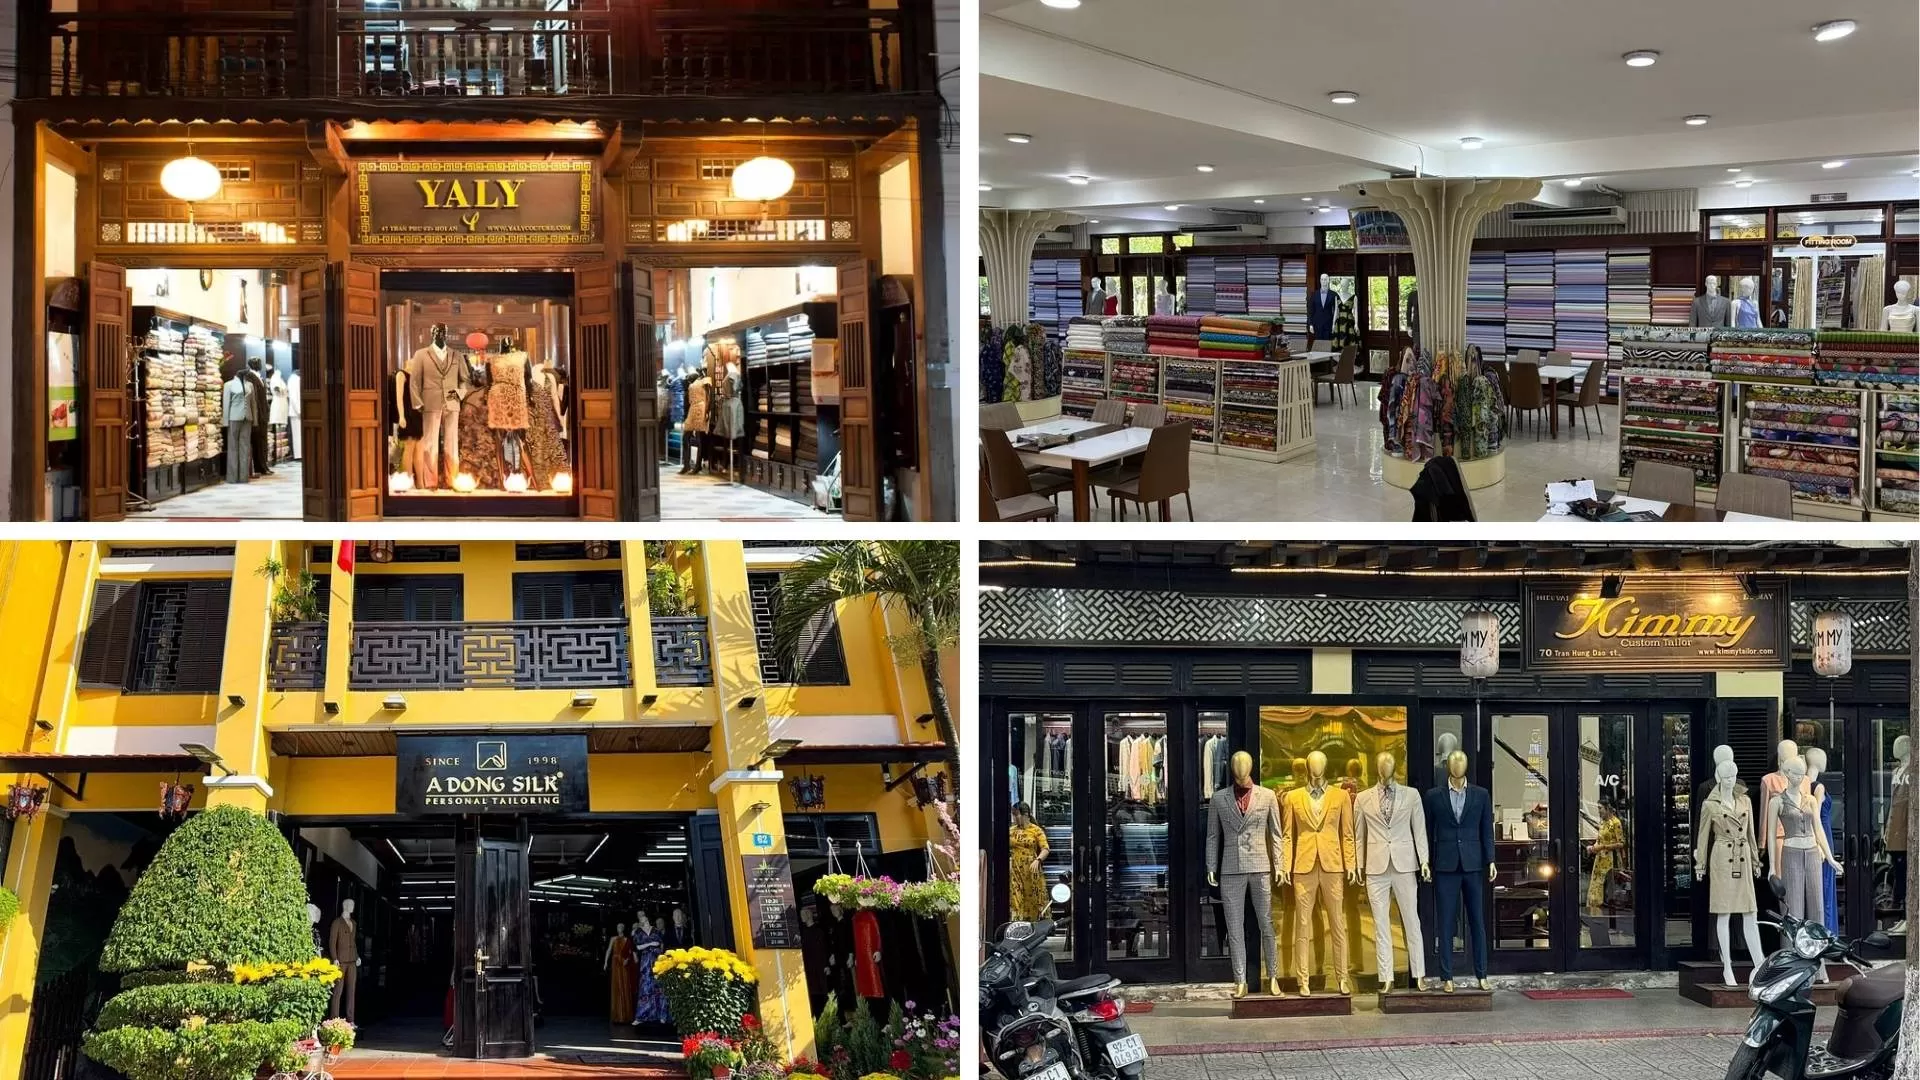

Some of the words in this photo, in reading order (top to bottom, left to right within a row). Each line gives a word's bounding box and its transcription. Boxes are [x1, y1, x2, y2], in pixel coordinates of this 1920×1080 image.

[416, 178, 526, 208] YALY
[1555, 596, 1756, 648] Kimmy
[1620, 638, 1661, 648] Custom
[1664, 638, 1693, 648] Tailor
[1539, 648, 1553, 657] 70
[1572, 650, 1590, 658] Hung
[1698, 648, 1774, 656] www.kimmytailor.com
[424, 757, 460, 766] SINCE
[527, 756, 558, 765] 1998
[426, 777, 443, 793] A
[446, 776, 506, 793] DONG
[1594, 774, 1620, 787] A/C
[425, 797, 488, 805] PERSONAL
[492, 796, 560, 805] TAILORING
[757, 834, 769, 845] 62
[1112, 1037, 1138, 1053] 92-C1
